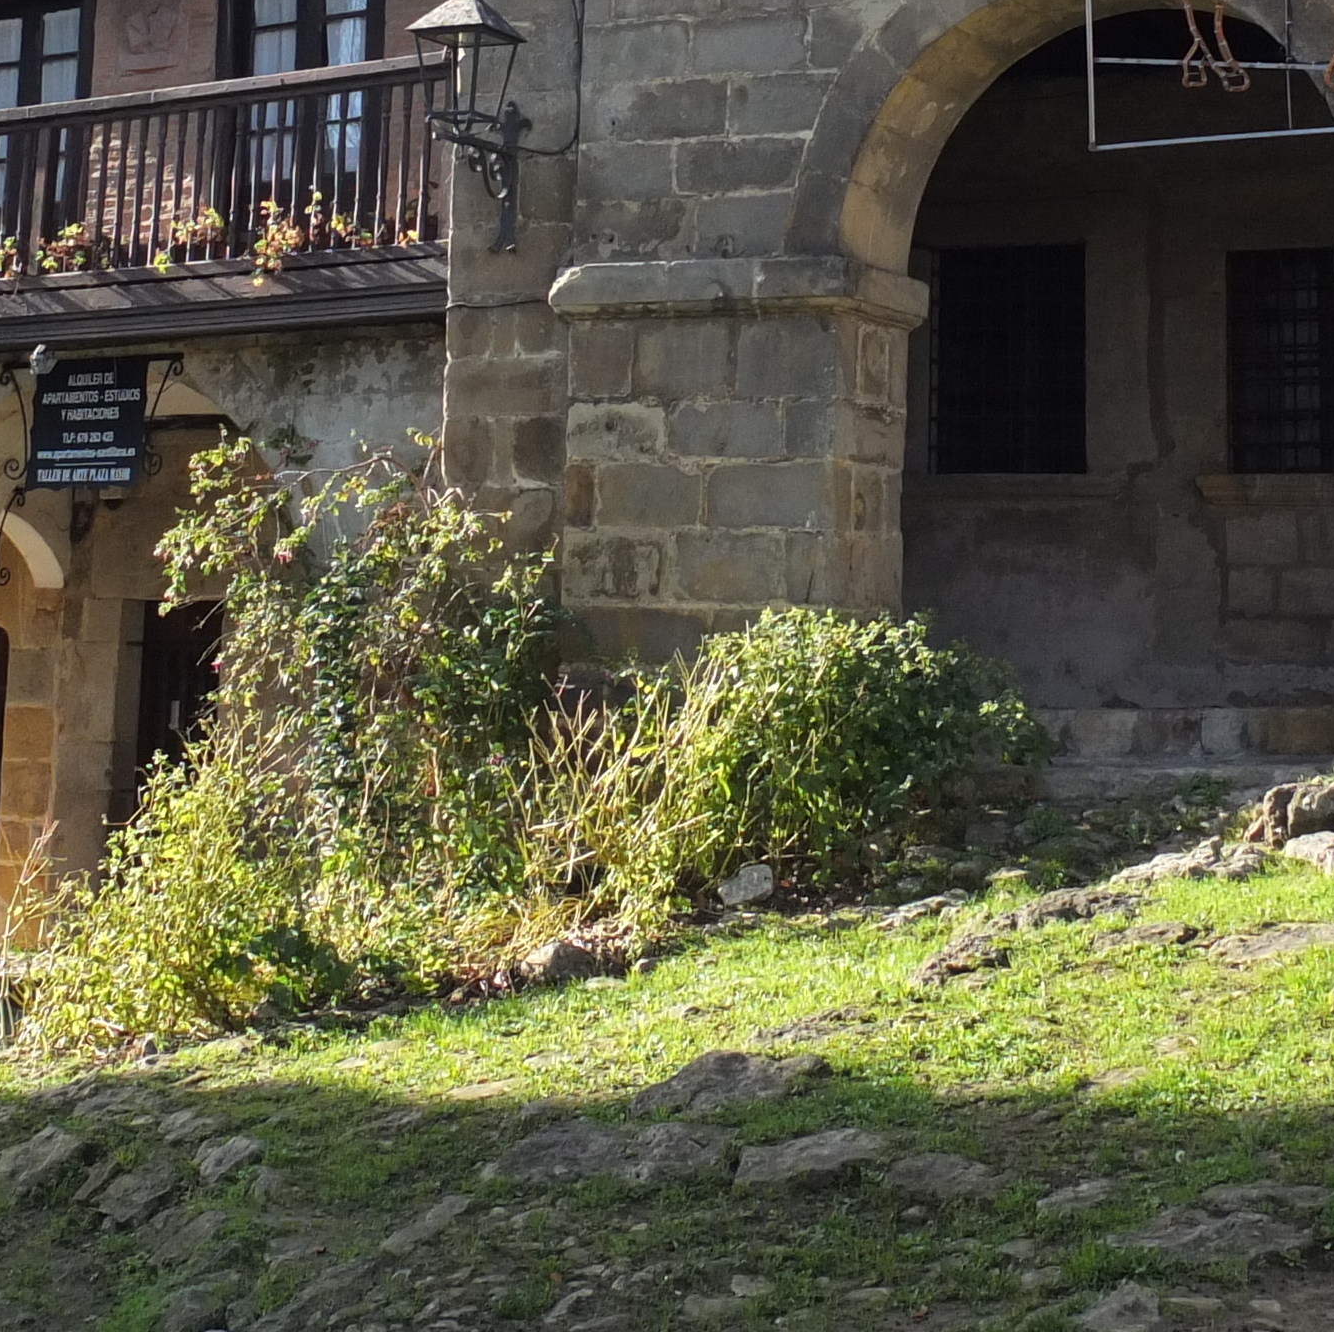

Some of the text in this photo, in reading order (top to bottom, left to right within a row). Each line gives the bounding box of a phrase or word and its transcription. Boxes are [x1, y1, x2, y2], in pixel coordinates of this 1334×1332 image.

[42, 390, 99, 405] APARTAMENTOS
[61, 406, 120, 421] Y HABITACIONES
